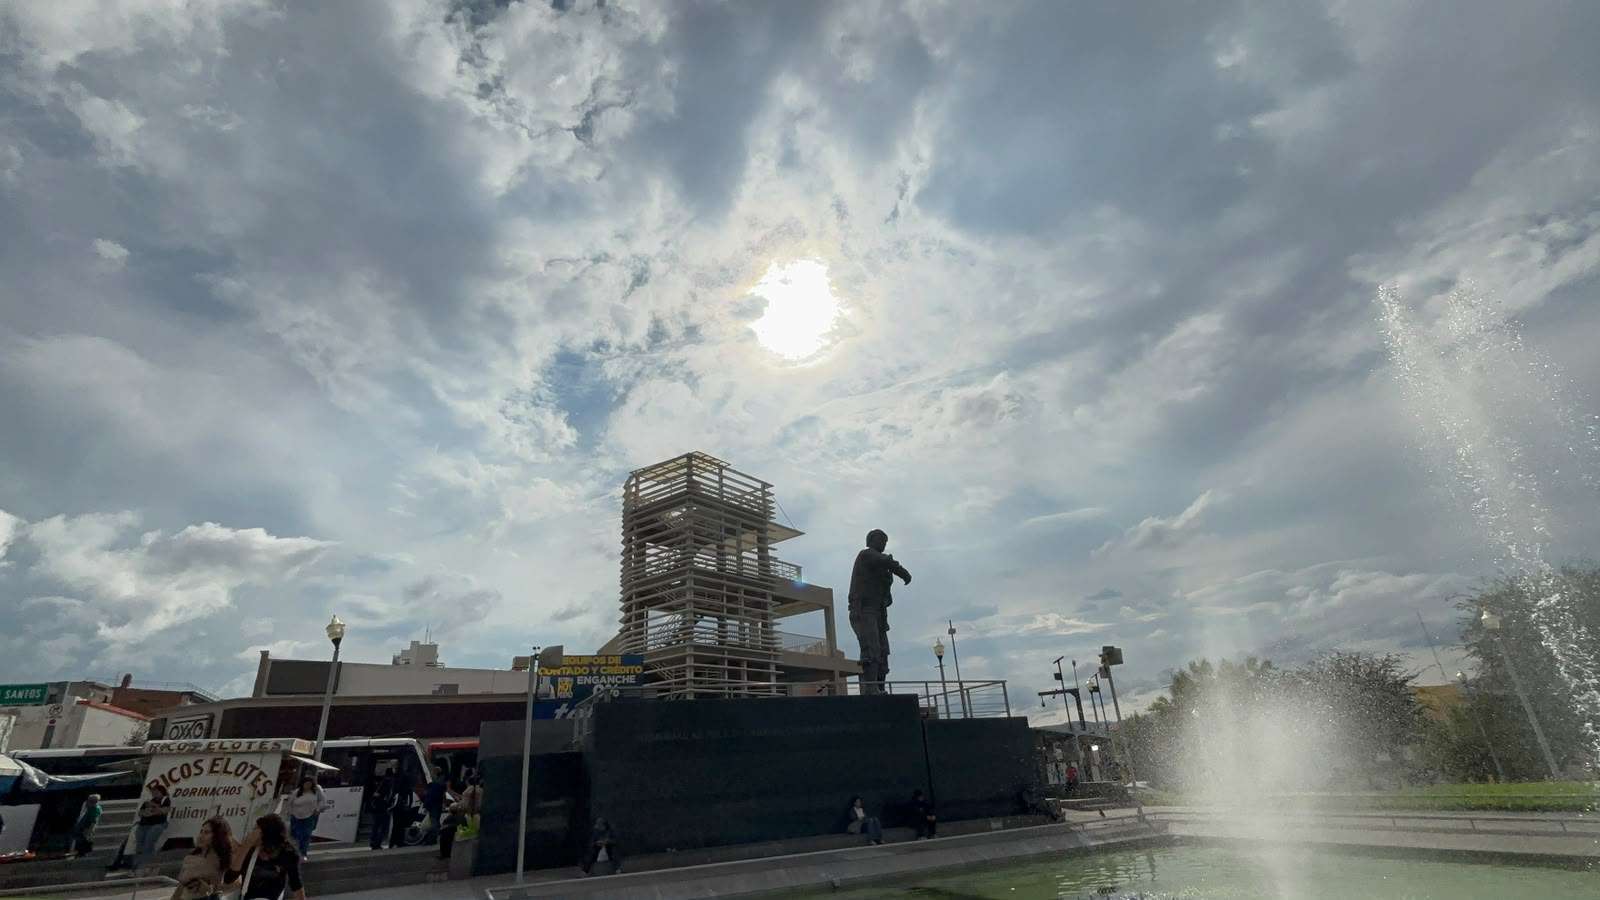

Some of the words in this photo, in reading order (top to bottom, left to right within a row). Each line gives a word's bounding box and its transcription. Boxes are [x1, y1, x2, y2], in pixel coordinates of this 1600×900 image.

[562, 655, 606, 665] EQUIPOS
[591, 666, 599, 674] Y
[577, 676, 636, 685] ENGANCHE
[4, 688, 42, 699] SANTOS
[170, 722, 204, 740] OXXO
[207, 740, 281, 751] ELOTES
[146, 759, 204, 789] RICOS
[209, 757, 273, 797] ELOTES
[173, 786, 243, 798] DORINACHOS
[216, 804, 247, 819] Luis
